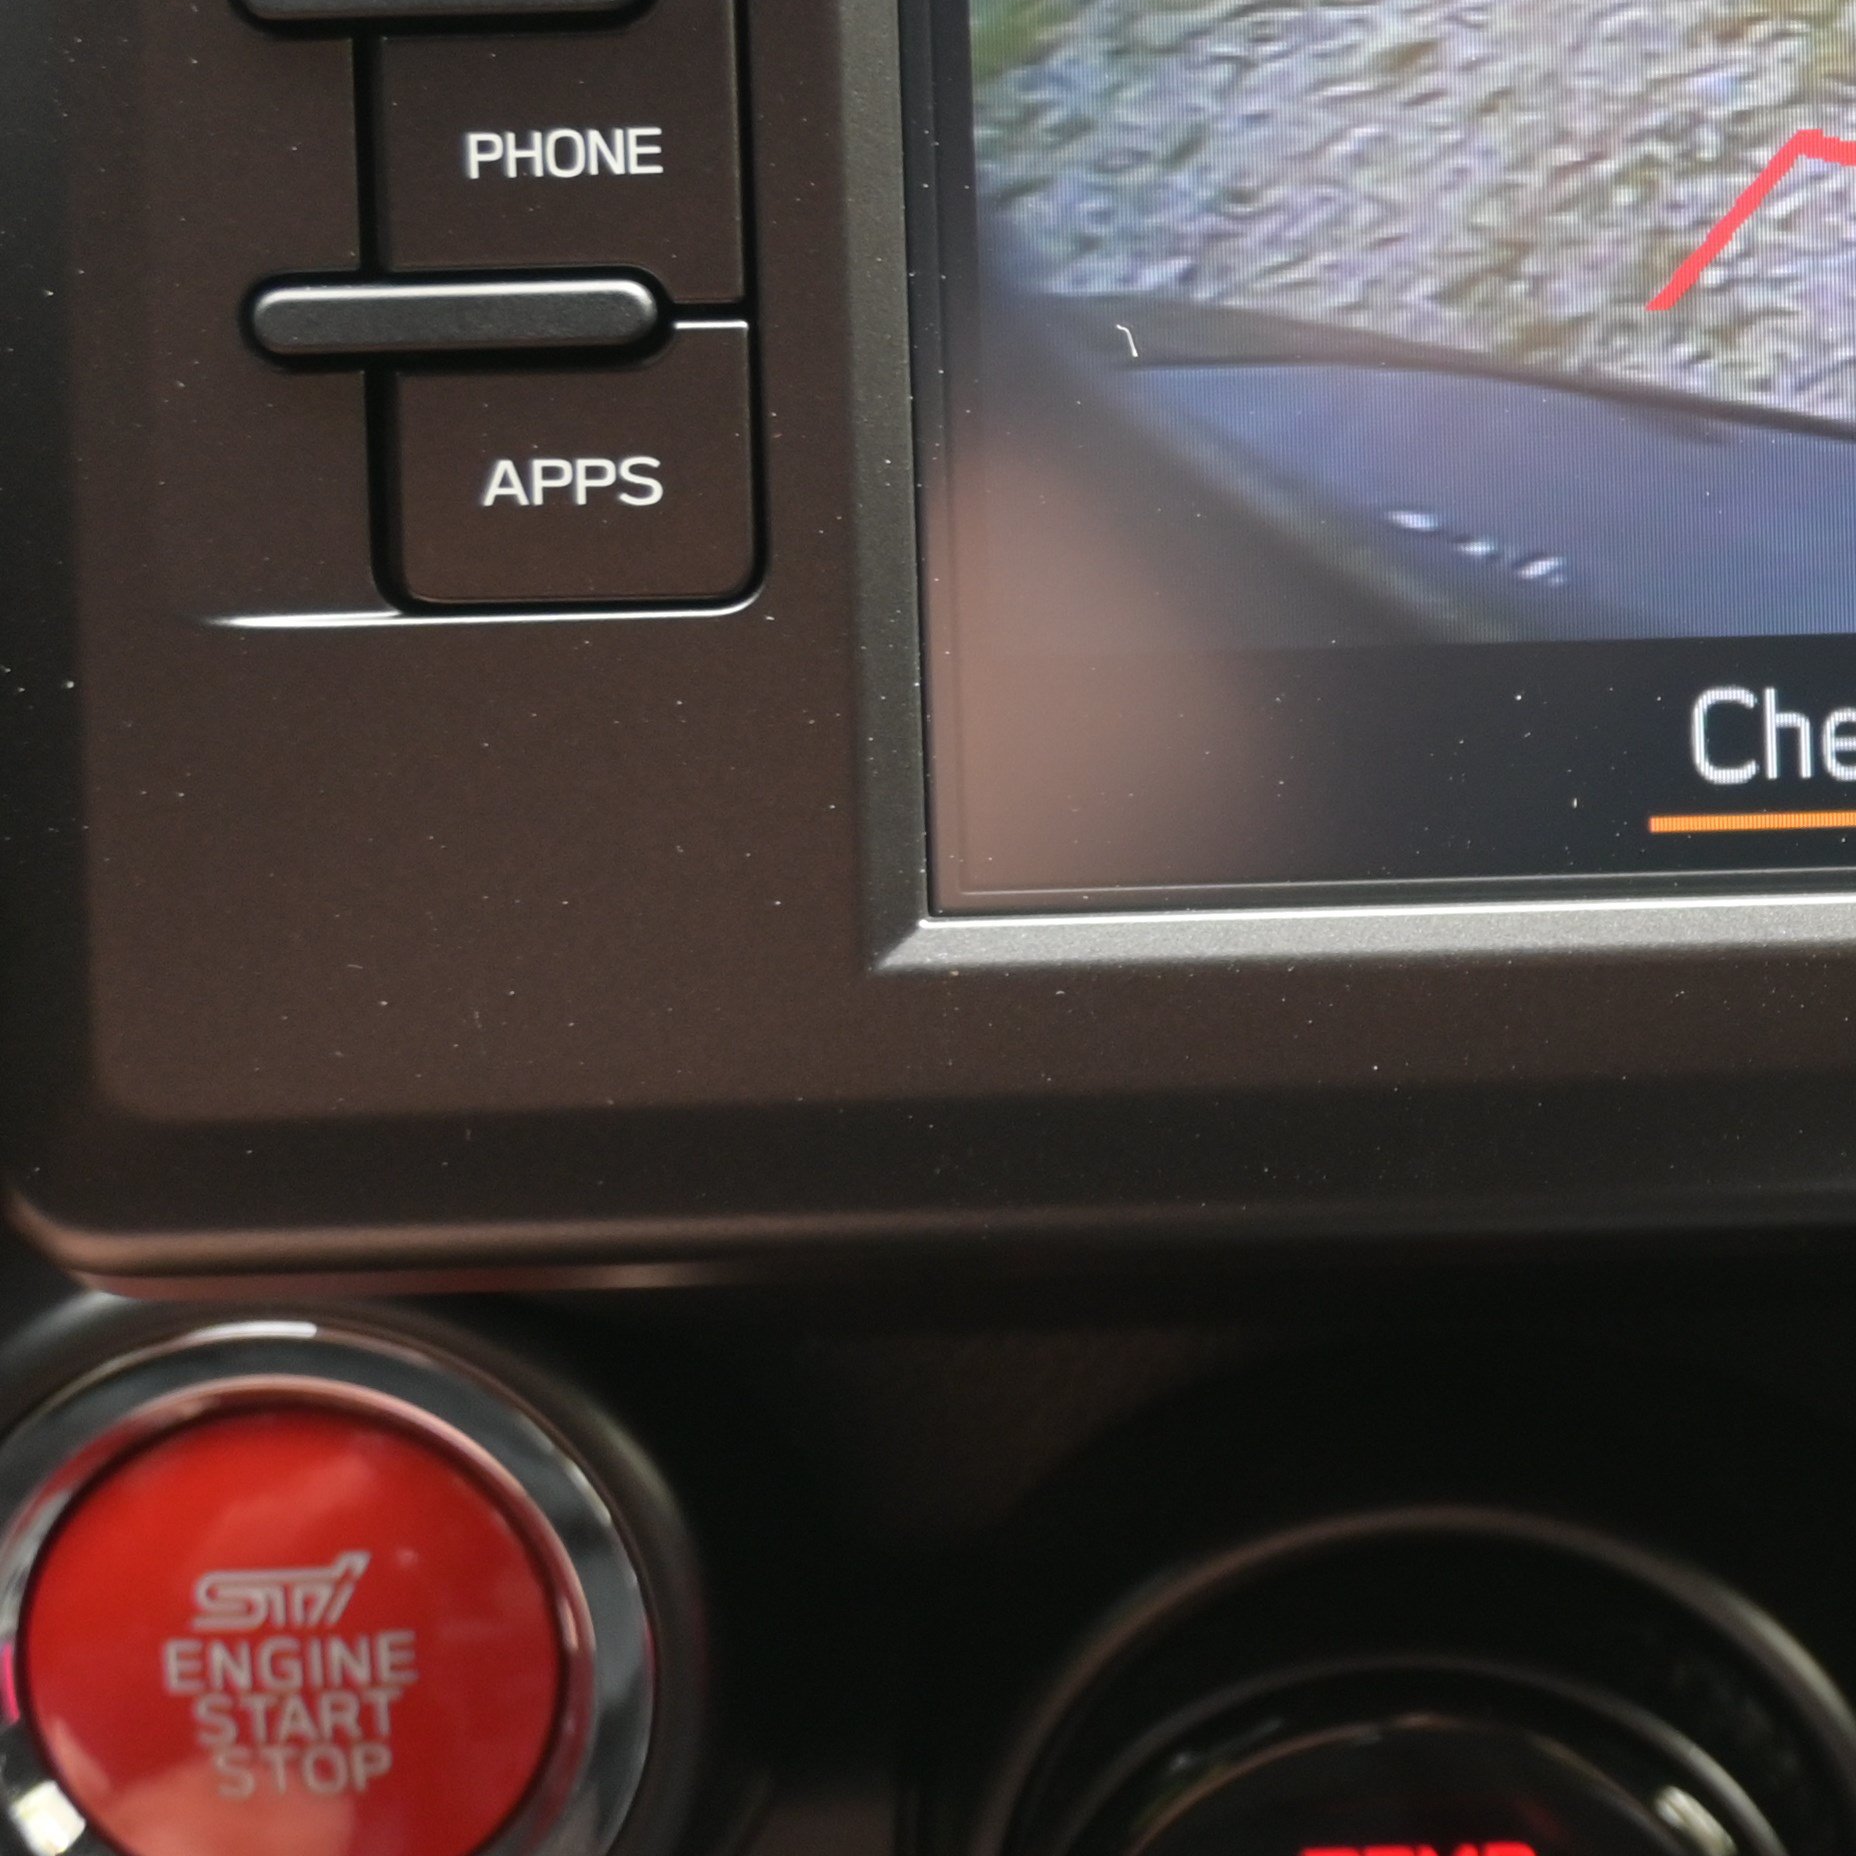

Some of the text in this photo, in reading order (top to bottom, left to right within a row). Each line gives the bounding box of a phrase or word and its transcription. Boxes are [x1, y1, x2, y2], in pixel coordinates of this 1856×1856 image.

[465, 126, 664, 180] PHONE
[481, 455, 664, 507] APPS
[164, 1629, 419, 1693] ENGINE
[195, 1686, 404, 1746] START
[213, 1742, 392, 1799] STOP
